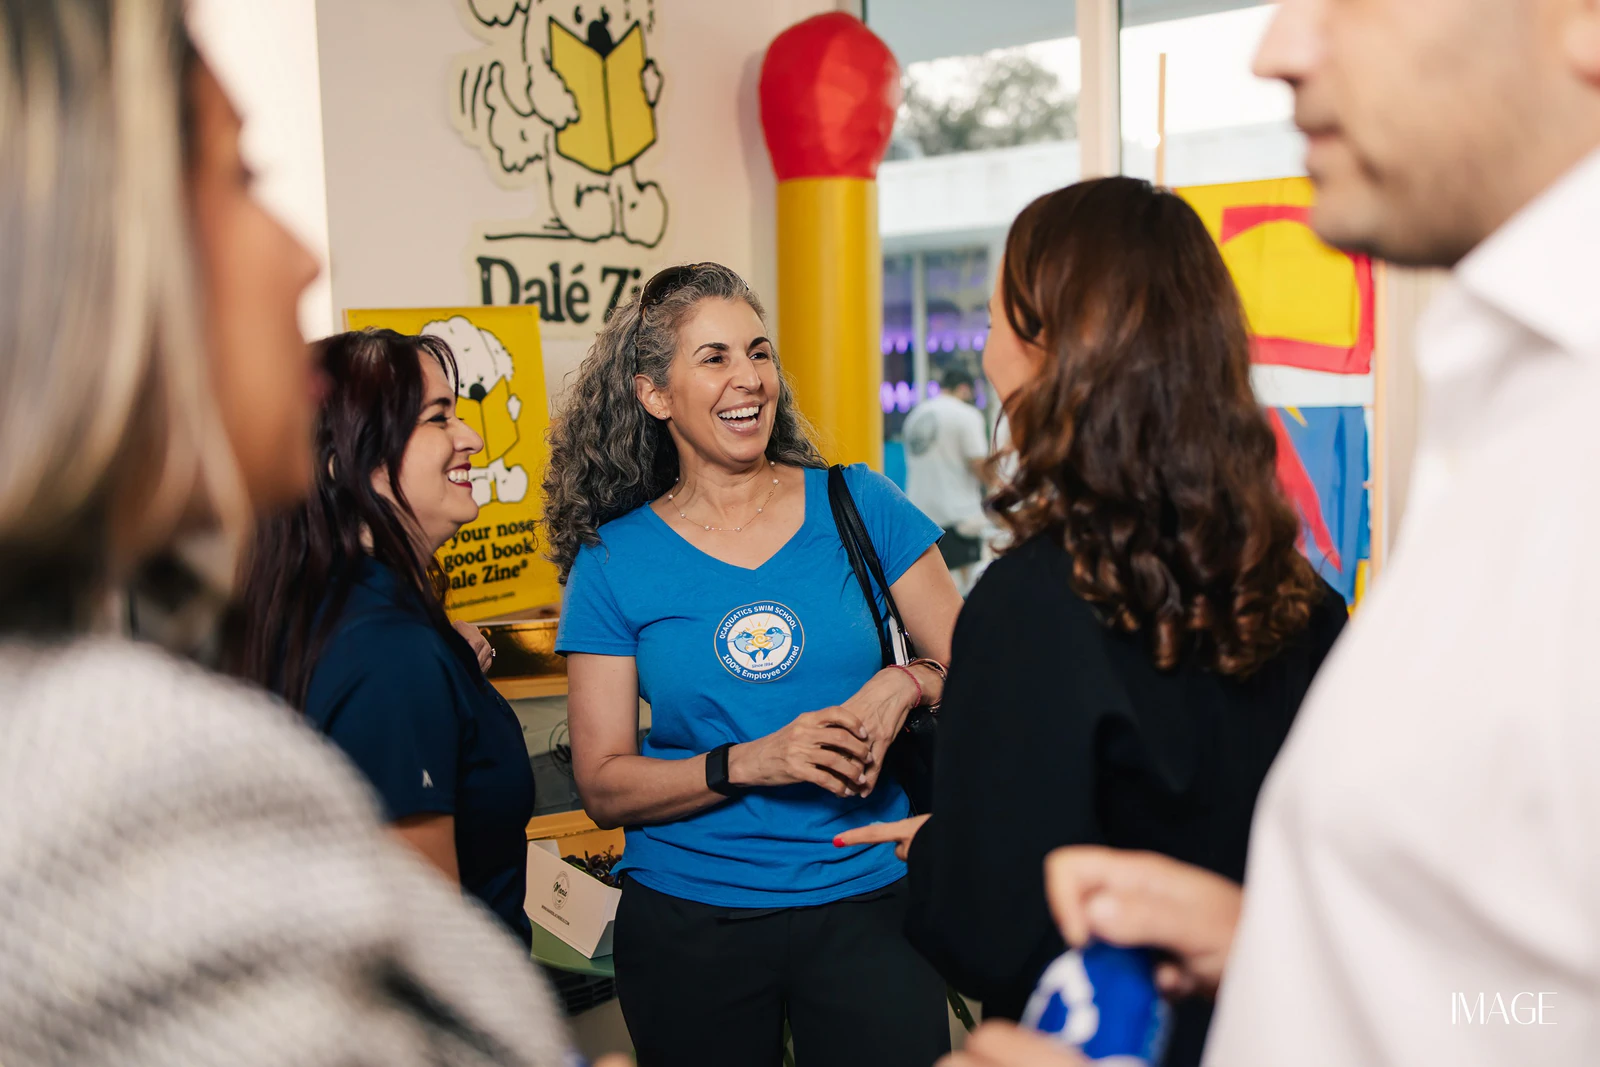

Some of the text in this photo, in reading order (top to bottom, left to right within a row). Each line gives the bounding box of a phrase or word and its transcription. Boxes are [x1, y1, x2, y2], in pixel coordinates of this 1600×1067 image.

[476, 256, 590, 324] Dalé
[450, 519, 535, 549] your nose
[443, 537, 535, 573] good book
[451, 570, 478, 590] ale
[753, 605, 774, 613] SWIM
[774, 606, 798, 631] SCHOOL
[722, 645, 800, 680] 100% Employee Owned
